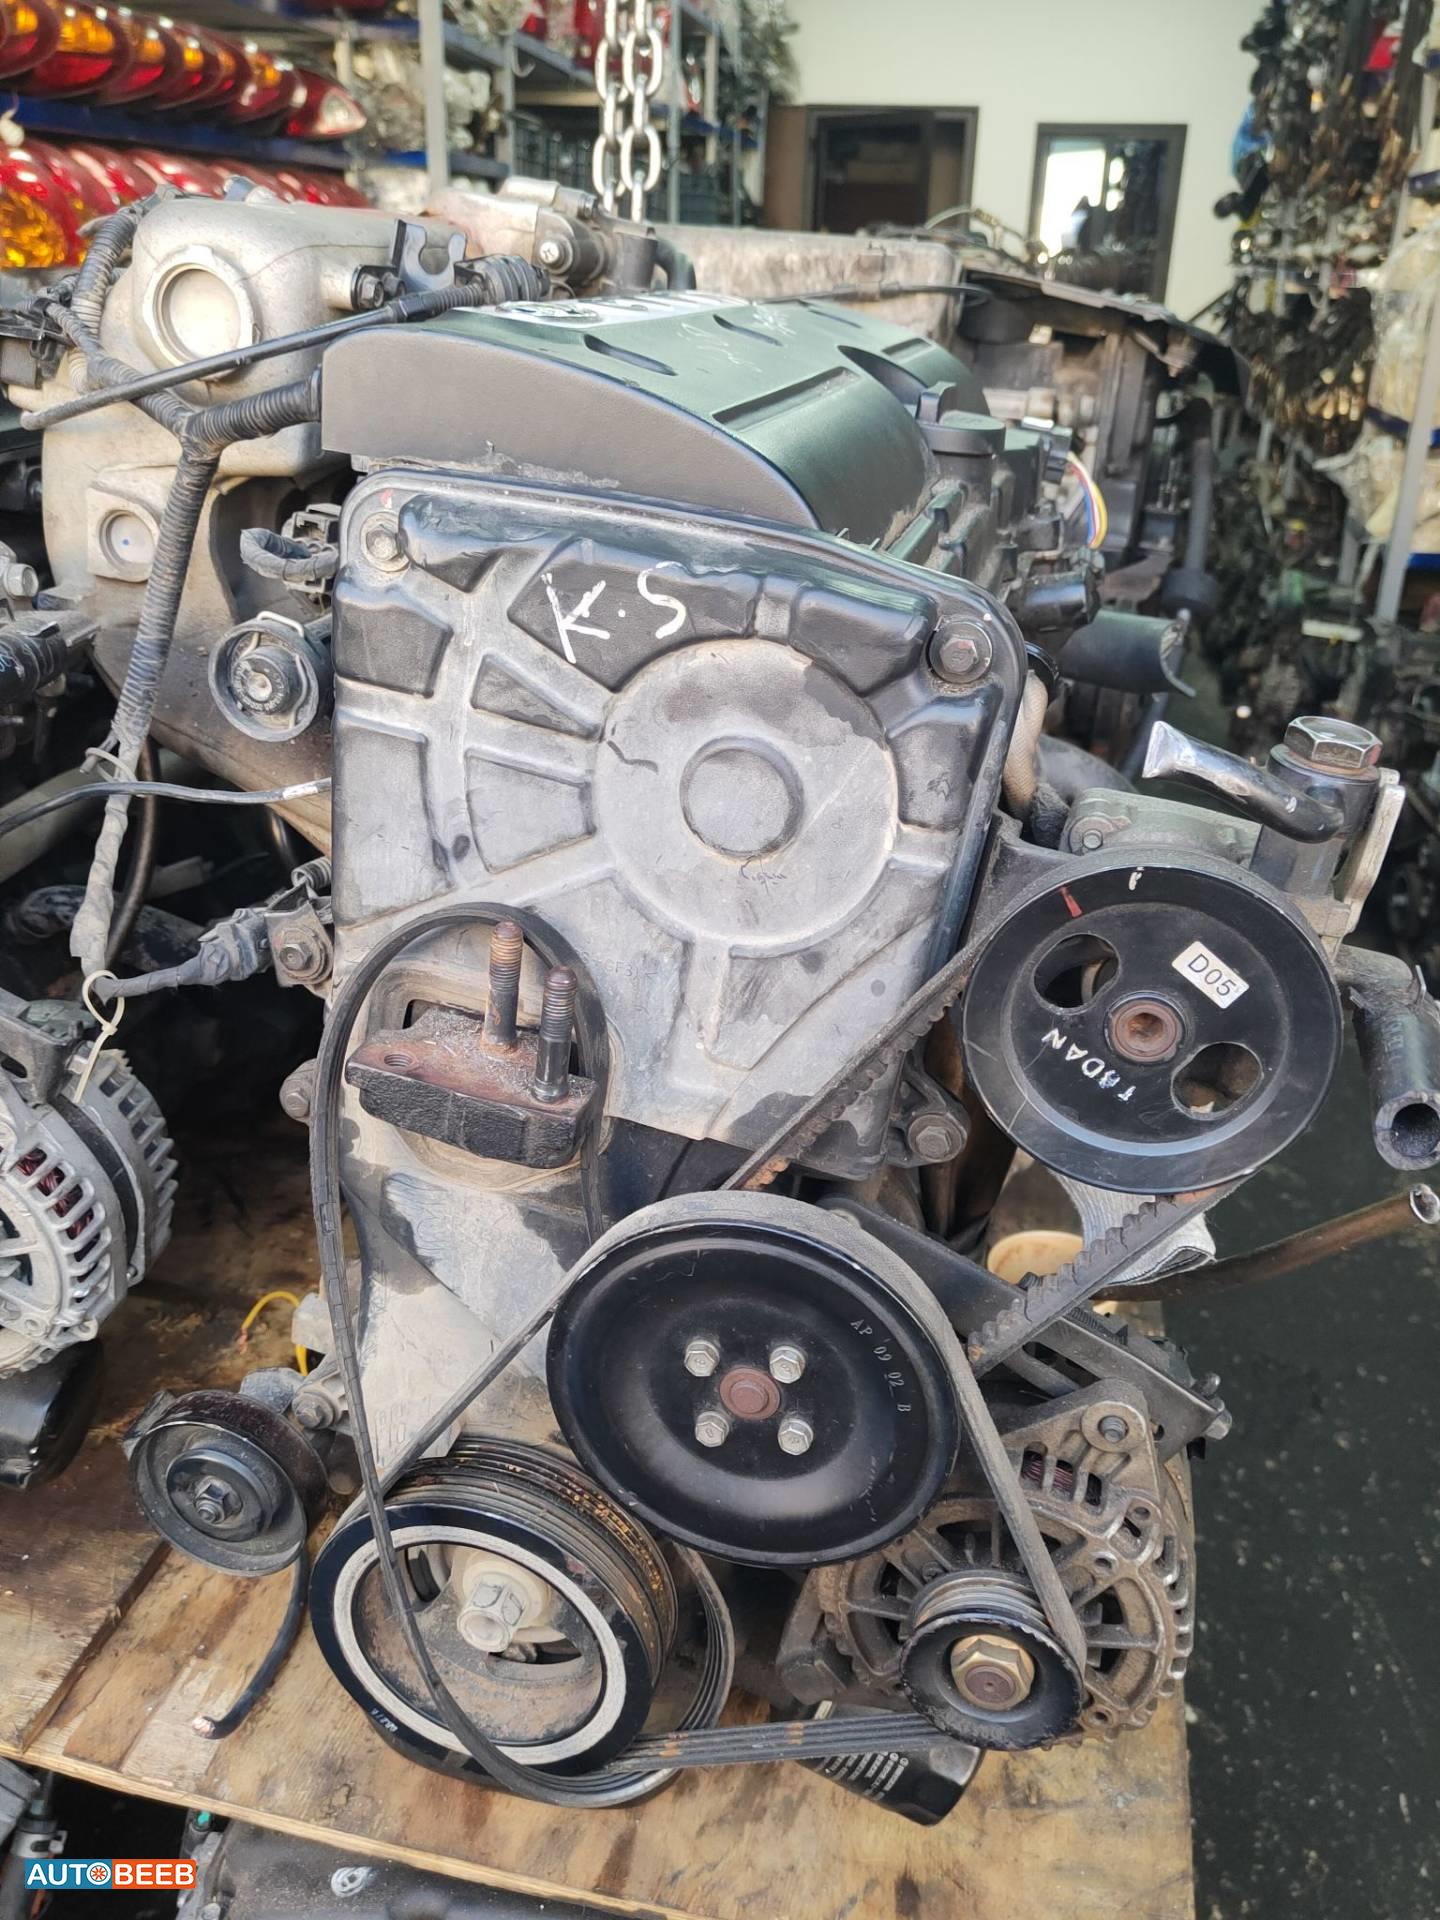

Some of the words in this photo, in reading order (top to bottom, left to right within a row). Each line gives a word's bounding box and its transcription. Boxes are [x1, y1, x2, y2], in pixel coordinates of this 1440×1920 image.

[1188, 953, 1237, 996] D05
[850, 1319, 873, 1336] AP
[897, 1403, 912, 1412] B
